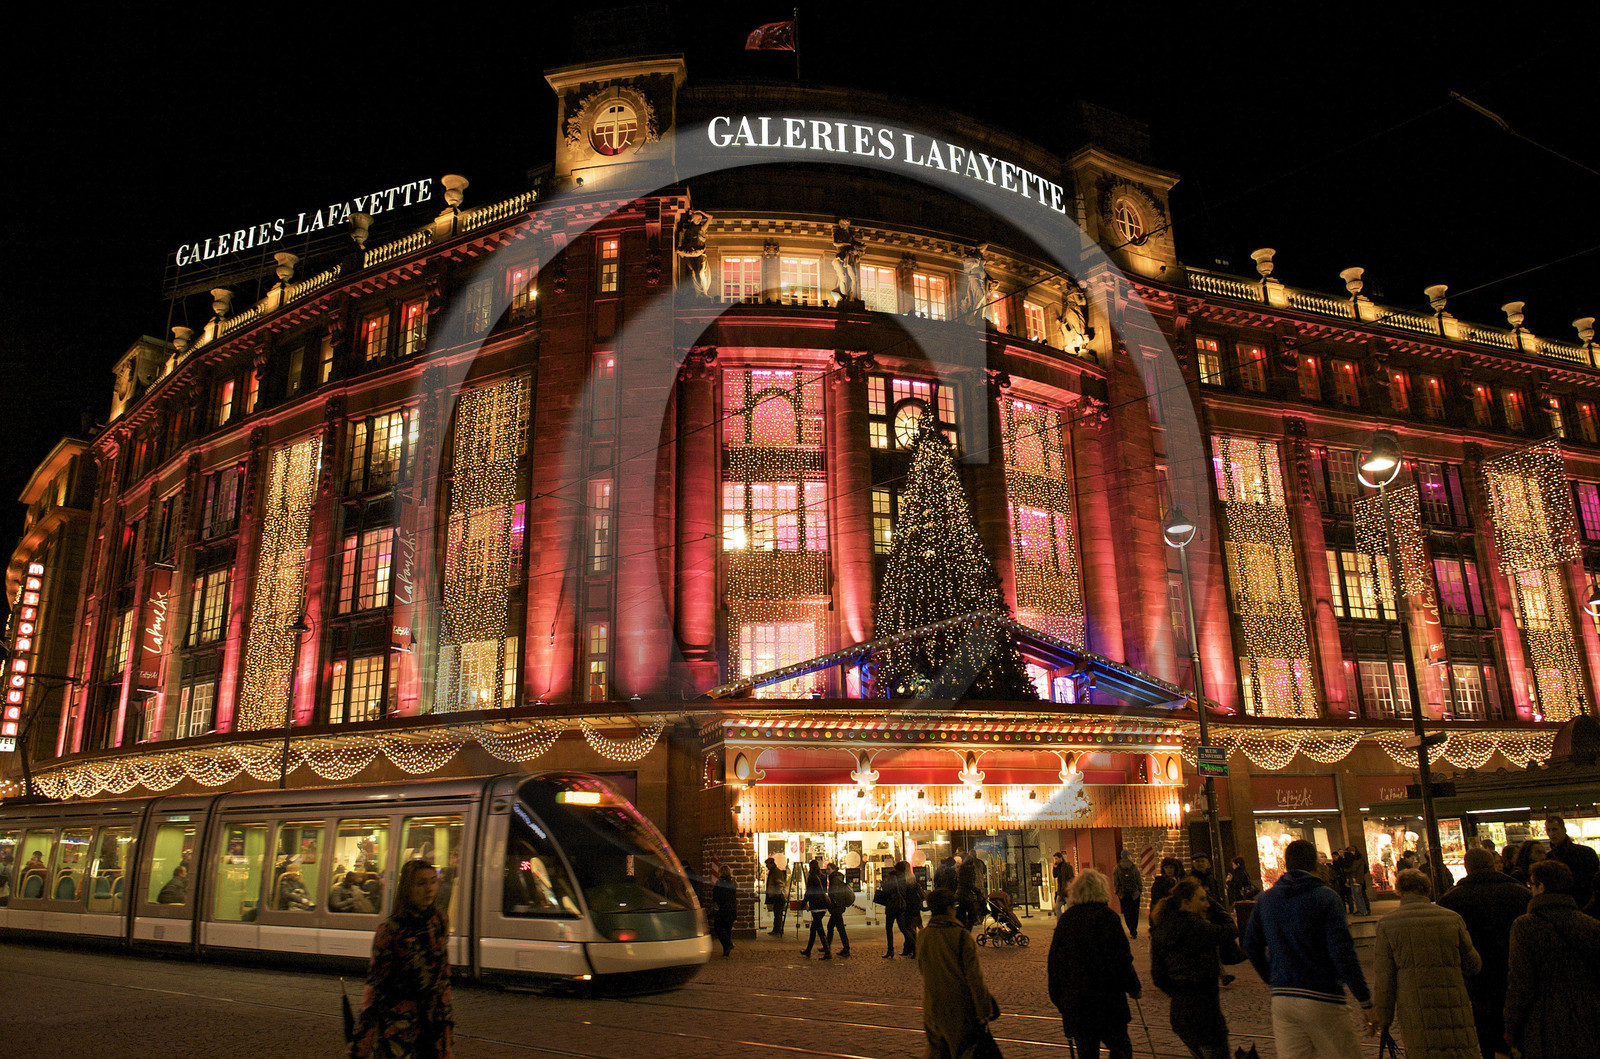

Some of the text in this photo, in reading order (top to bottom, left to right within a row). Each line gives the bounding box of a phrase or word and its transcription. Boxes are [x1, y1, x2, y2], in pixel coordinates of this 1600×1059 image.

[707, 115, 1067, 215] GALERIES LAFAYETTE
[175, 178, 433, 267] GALERIES LAFAYETTE
[989, 802, 1001, 814] la
